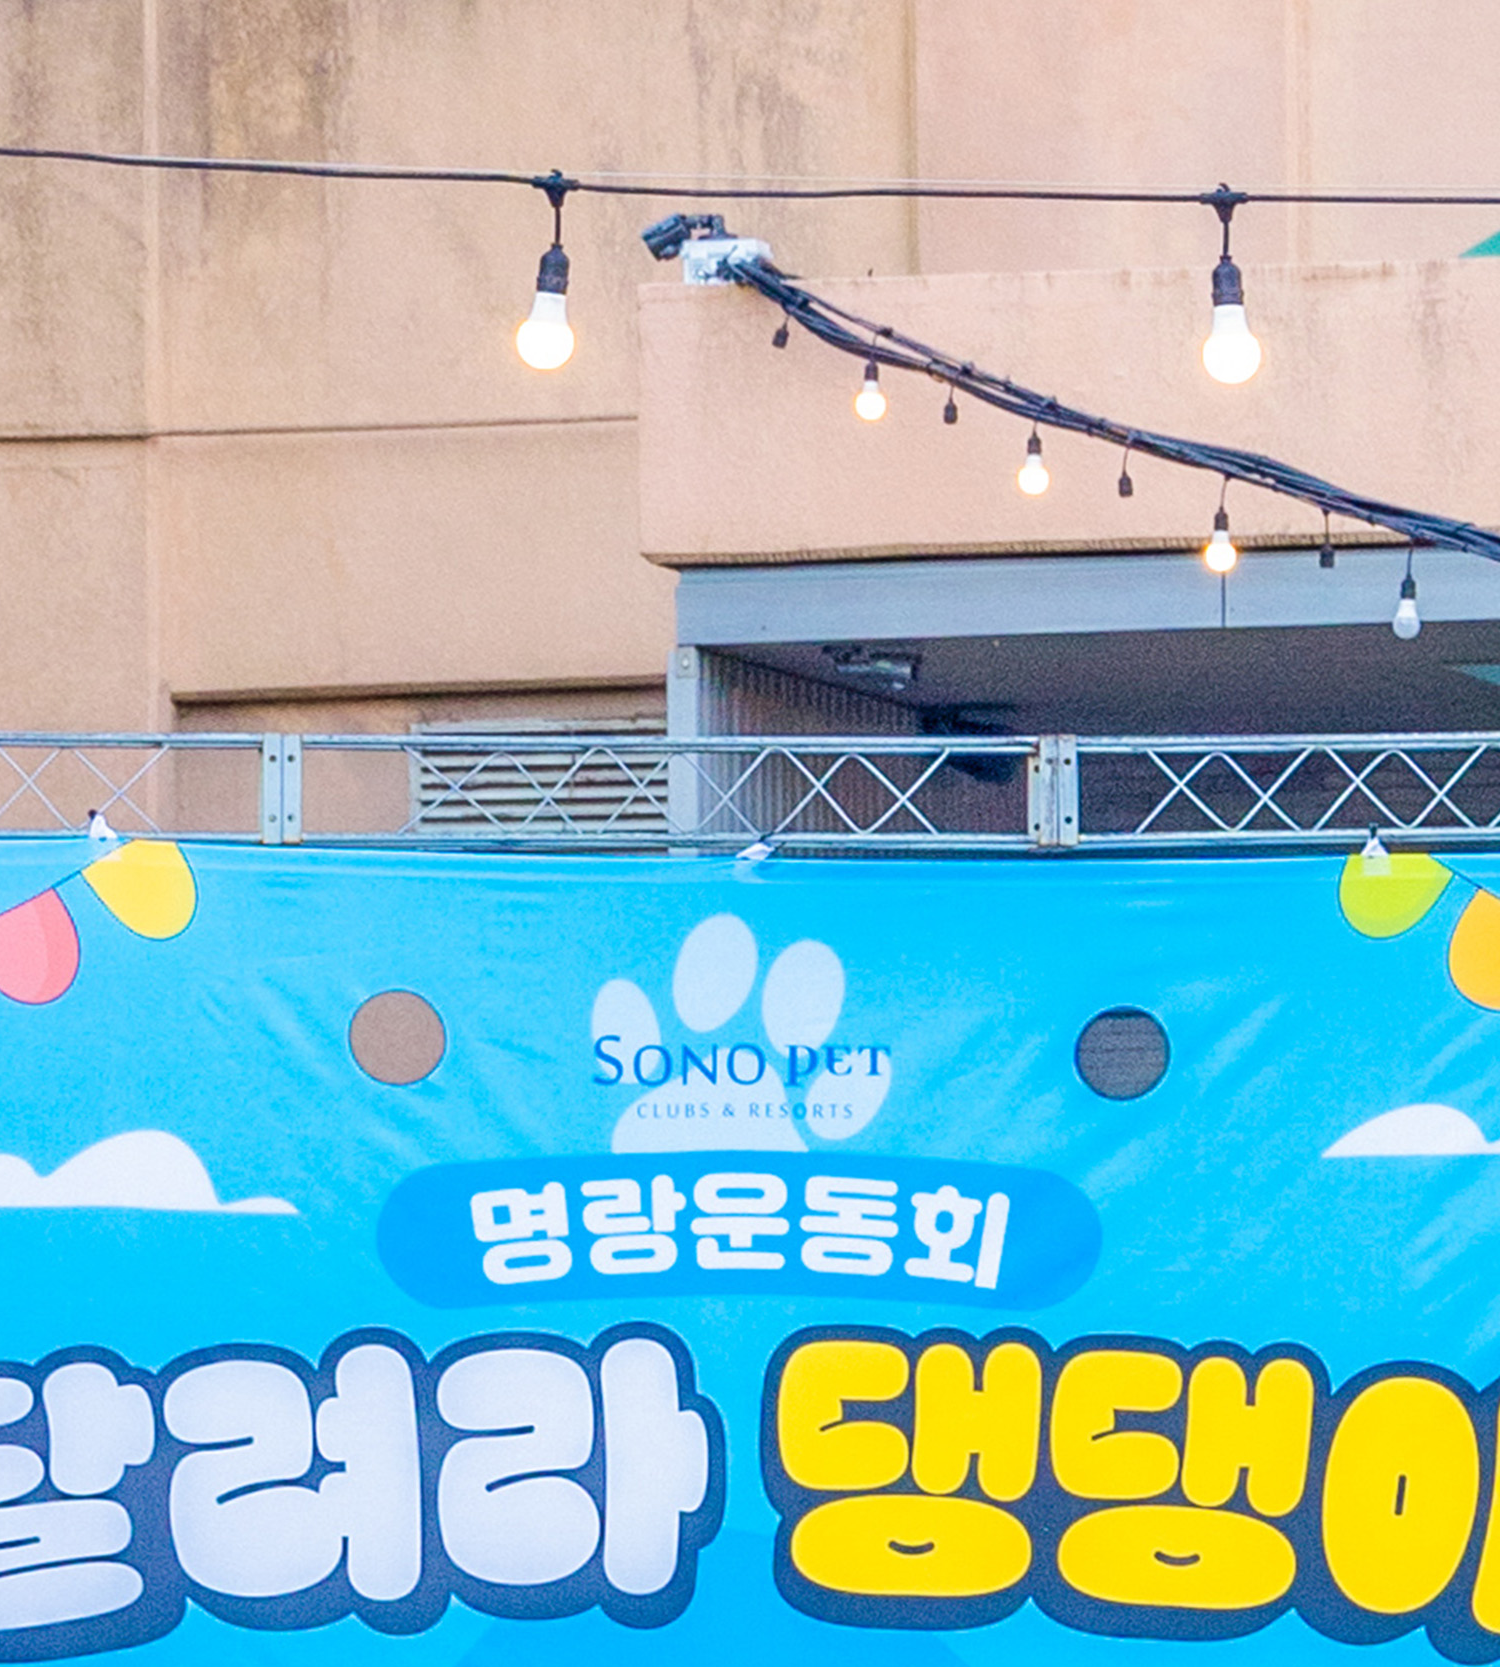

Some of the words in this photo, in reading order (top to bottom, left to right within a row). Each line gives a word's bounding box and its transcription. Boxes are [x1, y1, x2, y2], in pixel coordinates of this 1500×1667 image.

[594, 1035, 766, 1086] SONO
[636, 1102, 710, 1119] CLUBS
[748, 1102, 853, 1120] RESORTS
[469, 1172, 1010, 1290] 명랑운동회
